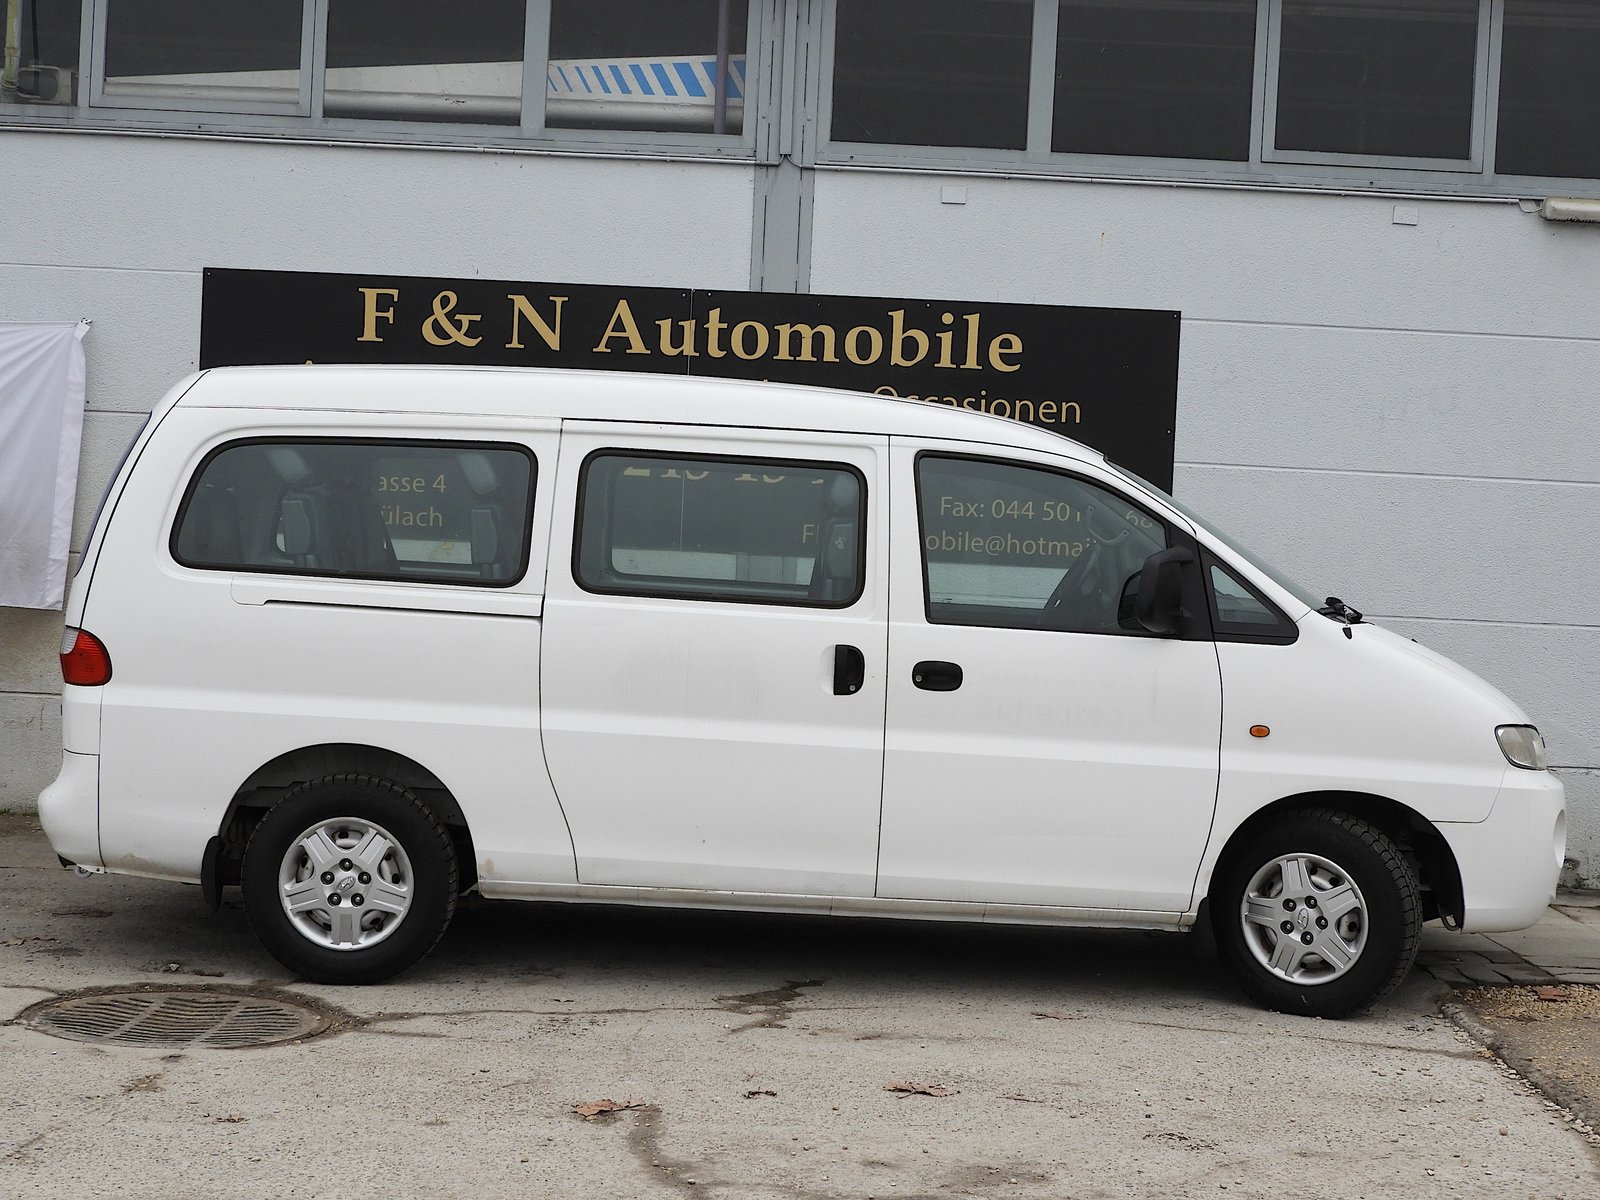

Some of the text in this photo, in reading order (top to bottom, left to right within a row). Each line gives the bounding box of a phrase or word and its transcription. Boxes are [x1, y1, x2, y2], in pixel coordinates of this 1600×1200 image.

[356, 287, 1025, 374] F & N Automobile
[432, 474, 447, 493] 4
[940, 496, 985, 519] Fax:
[991, 499, 1034, 520] 044
